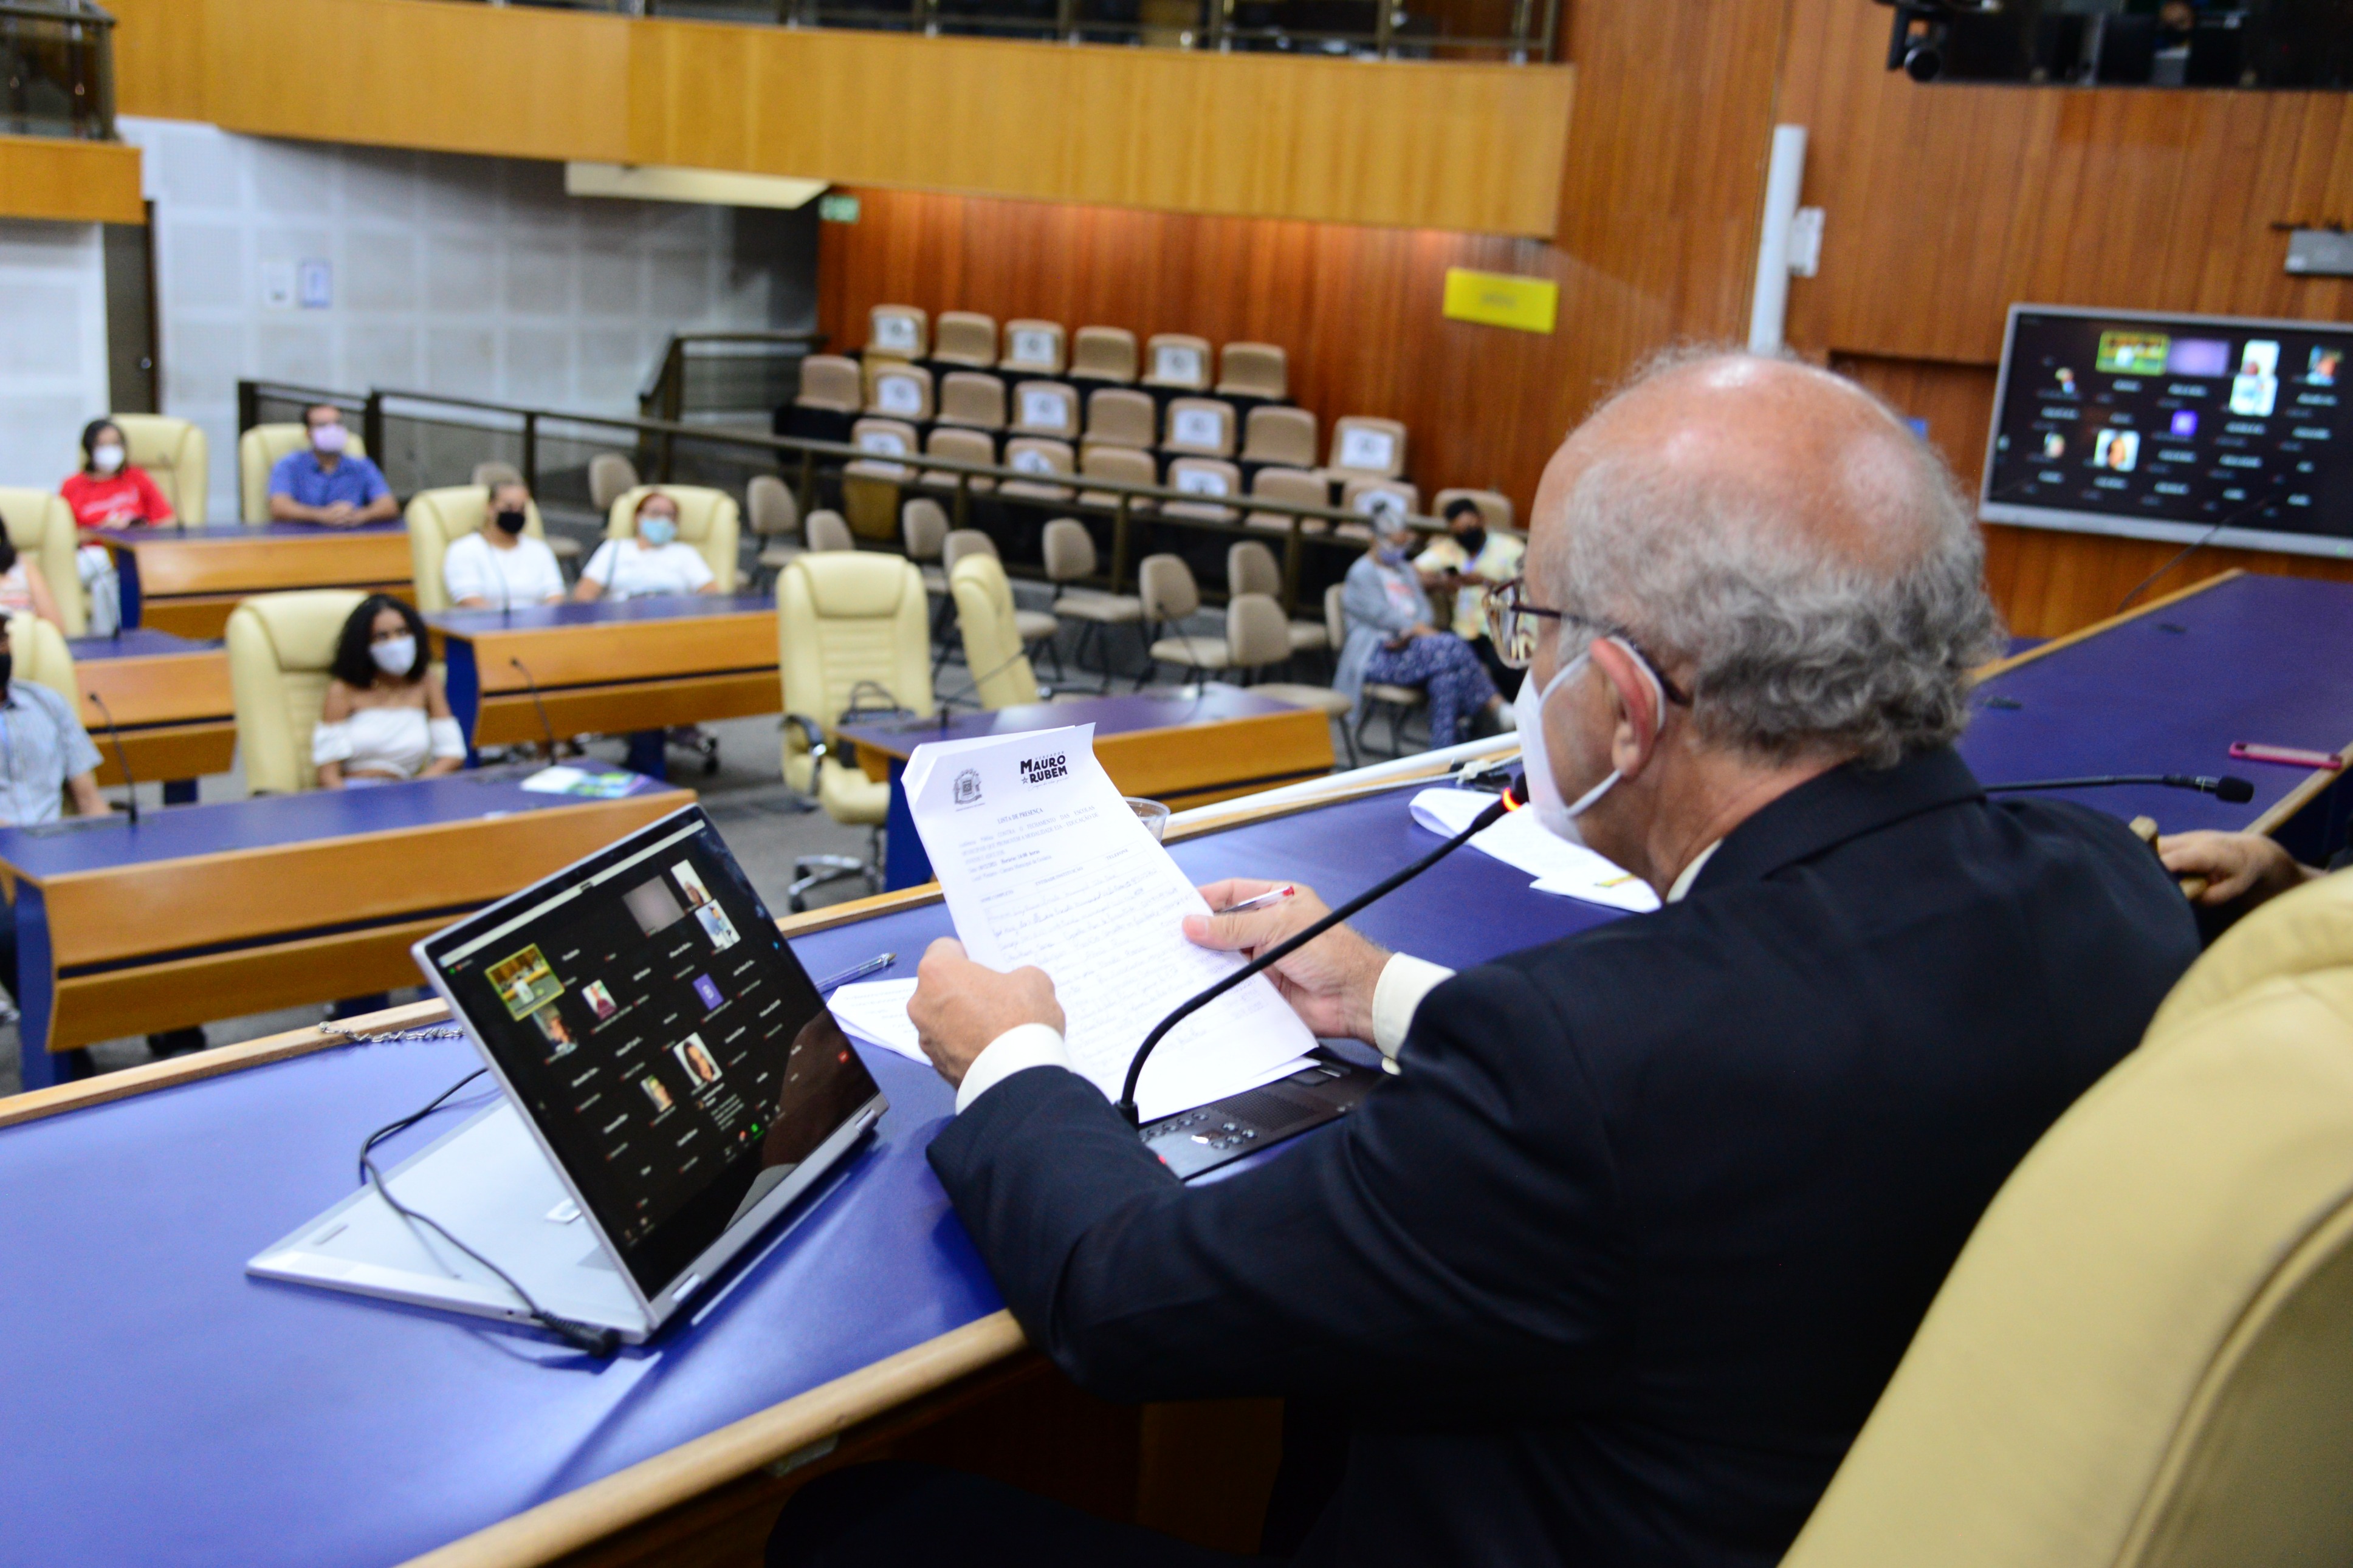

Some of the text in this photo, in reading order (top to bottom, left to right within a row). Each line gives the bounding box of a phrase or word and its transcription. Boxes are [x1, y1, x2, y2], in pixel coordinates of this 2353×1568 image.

[1020, 755, 1066, 775] MAURO
[1035, 751, 1064, 760] VEREADOR
[1029, 765, 1068, 784] RUBEM
[997, 815, 1012, 824] LISTA
[1019, 808, 1043, 818] PRESENÇA
[1027, 818, 1056, 830] FECHAMENTO
[1074, 805, 1095, 815] ESCOLAS
